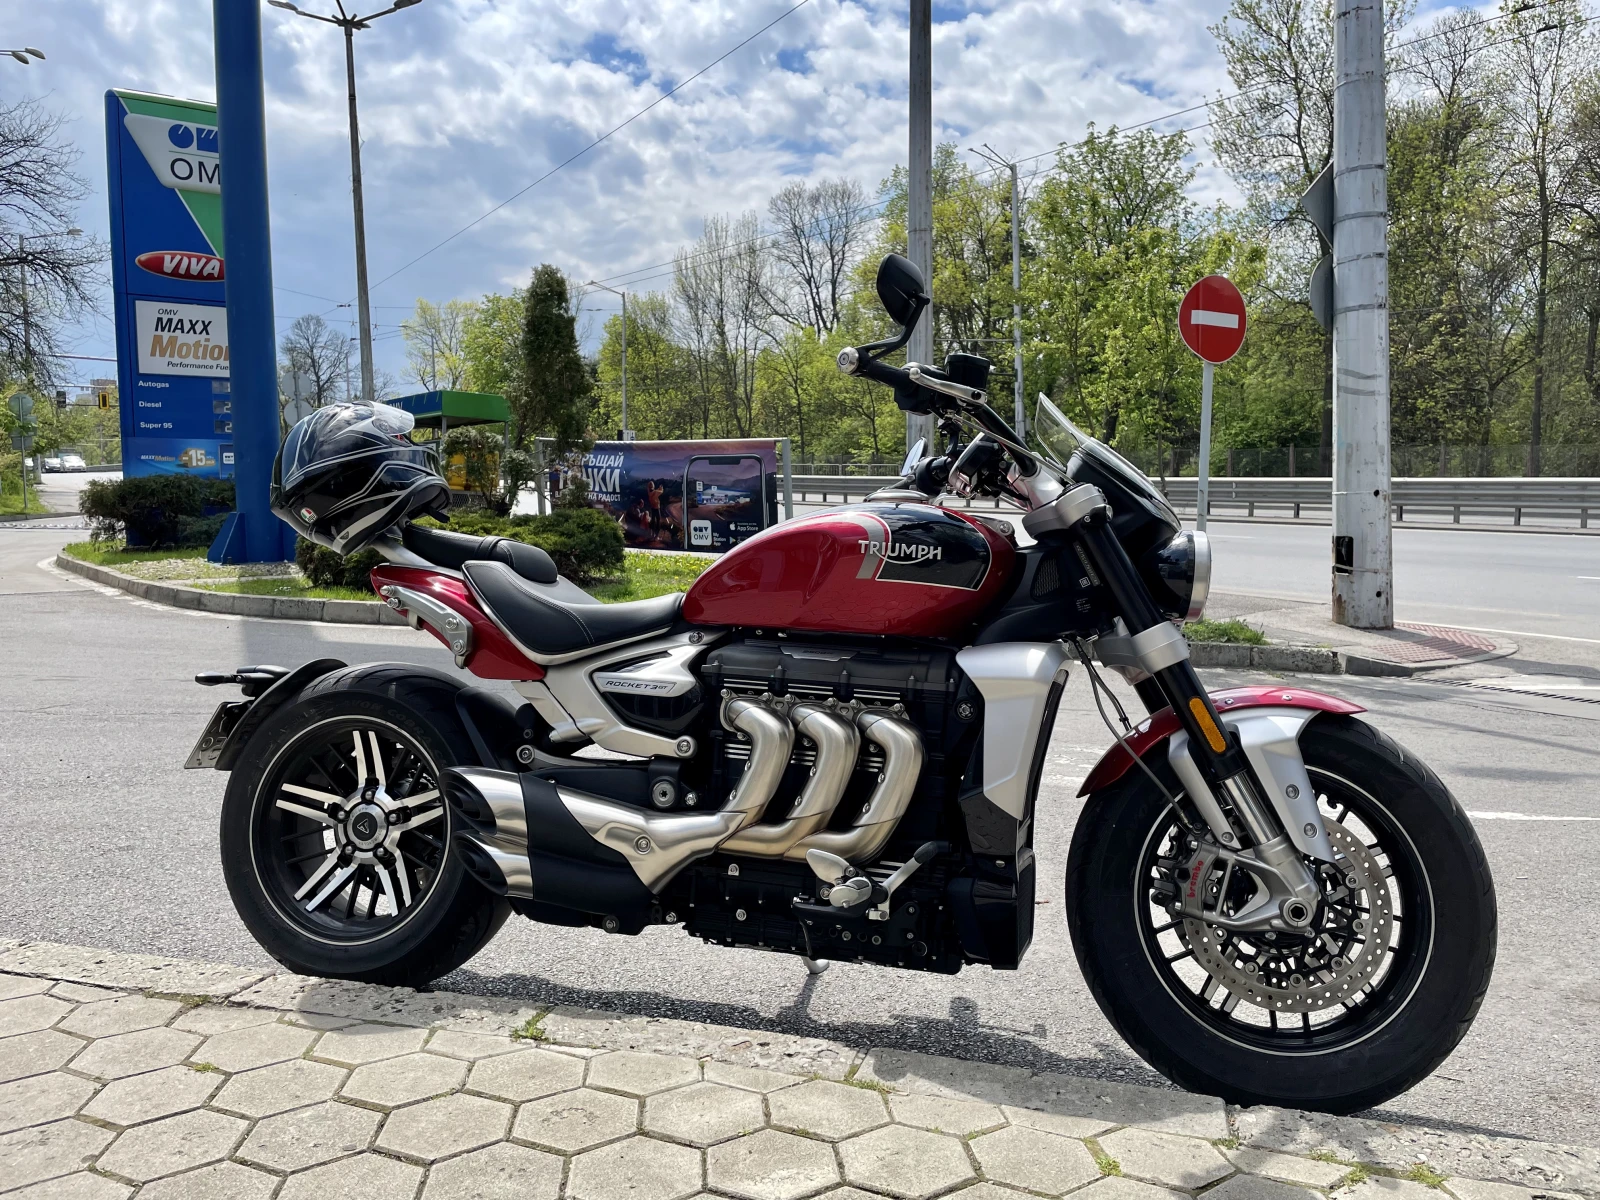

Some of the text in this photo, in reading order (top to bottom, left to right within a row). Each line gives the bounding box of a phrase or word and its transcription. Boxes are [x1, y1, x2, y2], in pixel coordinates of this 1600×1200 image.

[170, 157, 221, 185] OM
[163, 254, 221, 278] VIVA
[157, 308, 179, 316] OMV
[154, 316, 212, 335] MAXX
[167, 361, 229, 371] Performance Fue
[138, 380, 170, 389] Autogas
[138, 400, 162, 408] Diesel
[140, 421, 162, 429] Super
[556, 451, 624, 469] РЪЩАЙ
[598, 493, 621, 502] РАДОСТ
[858, 539, 942, 561] TRIUMPH
[1186, 860, 1204, 898] brembo
